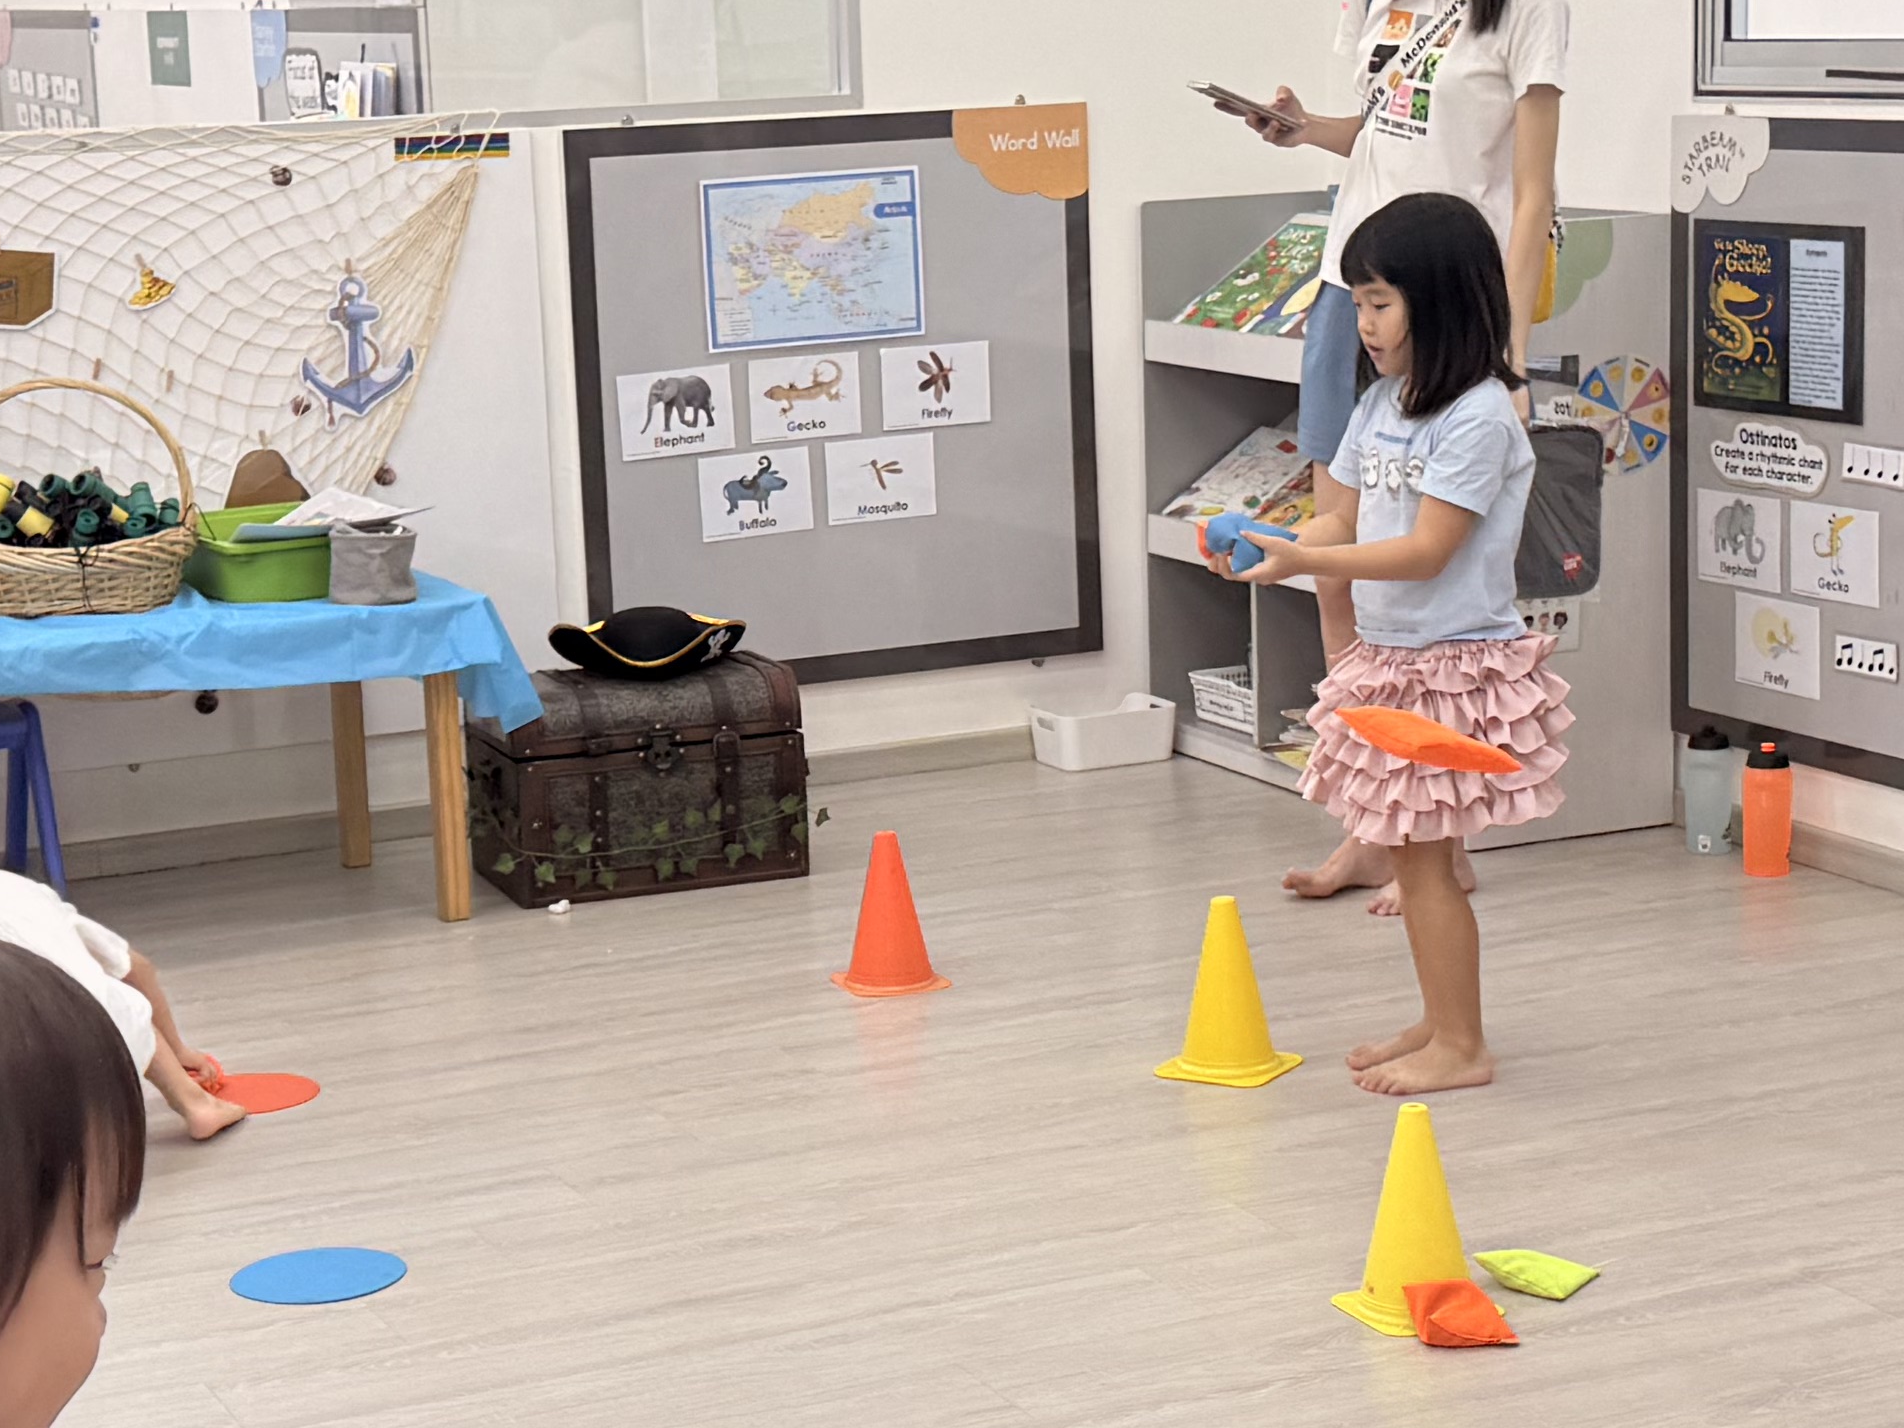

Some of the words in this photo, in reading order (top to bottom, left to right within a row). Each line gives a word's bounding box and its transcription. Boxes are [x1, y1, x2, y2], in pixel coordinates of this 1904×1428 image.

[989, 131, 1038, 152] Word
[1044, 128, 1080, 149] Wall
[921, 405, 954, 420] Firefly
[786, 418, 826, 432] Gecko
[654, 432, 705, 449] Elephant
[1739, 428, 1798, 450] Ostinatos
[1714, 445, 1746, 462] Create
[1747, 450, 1754, 461] a
[1755, 451, 1796, 469] rhythmic
[1798, 456, 1823, 471] chant
[1724, 461, 1740, 473] for
[1741, 463, 1764, 477] each
[1766, 467, 1814, 485] character.
[857, 500, 909, 517] Mosquito
[739, 516, 777, 531] Buffalo
[1719, 561, 1757, 578] Elephant
[1817, 577, 1849, 593] Gecko
[1763, 671, 1790, 689] Firefly
